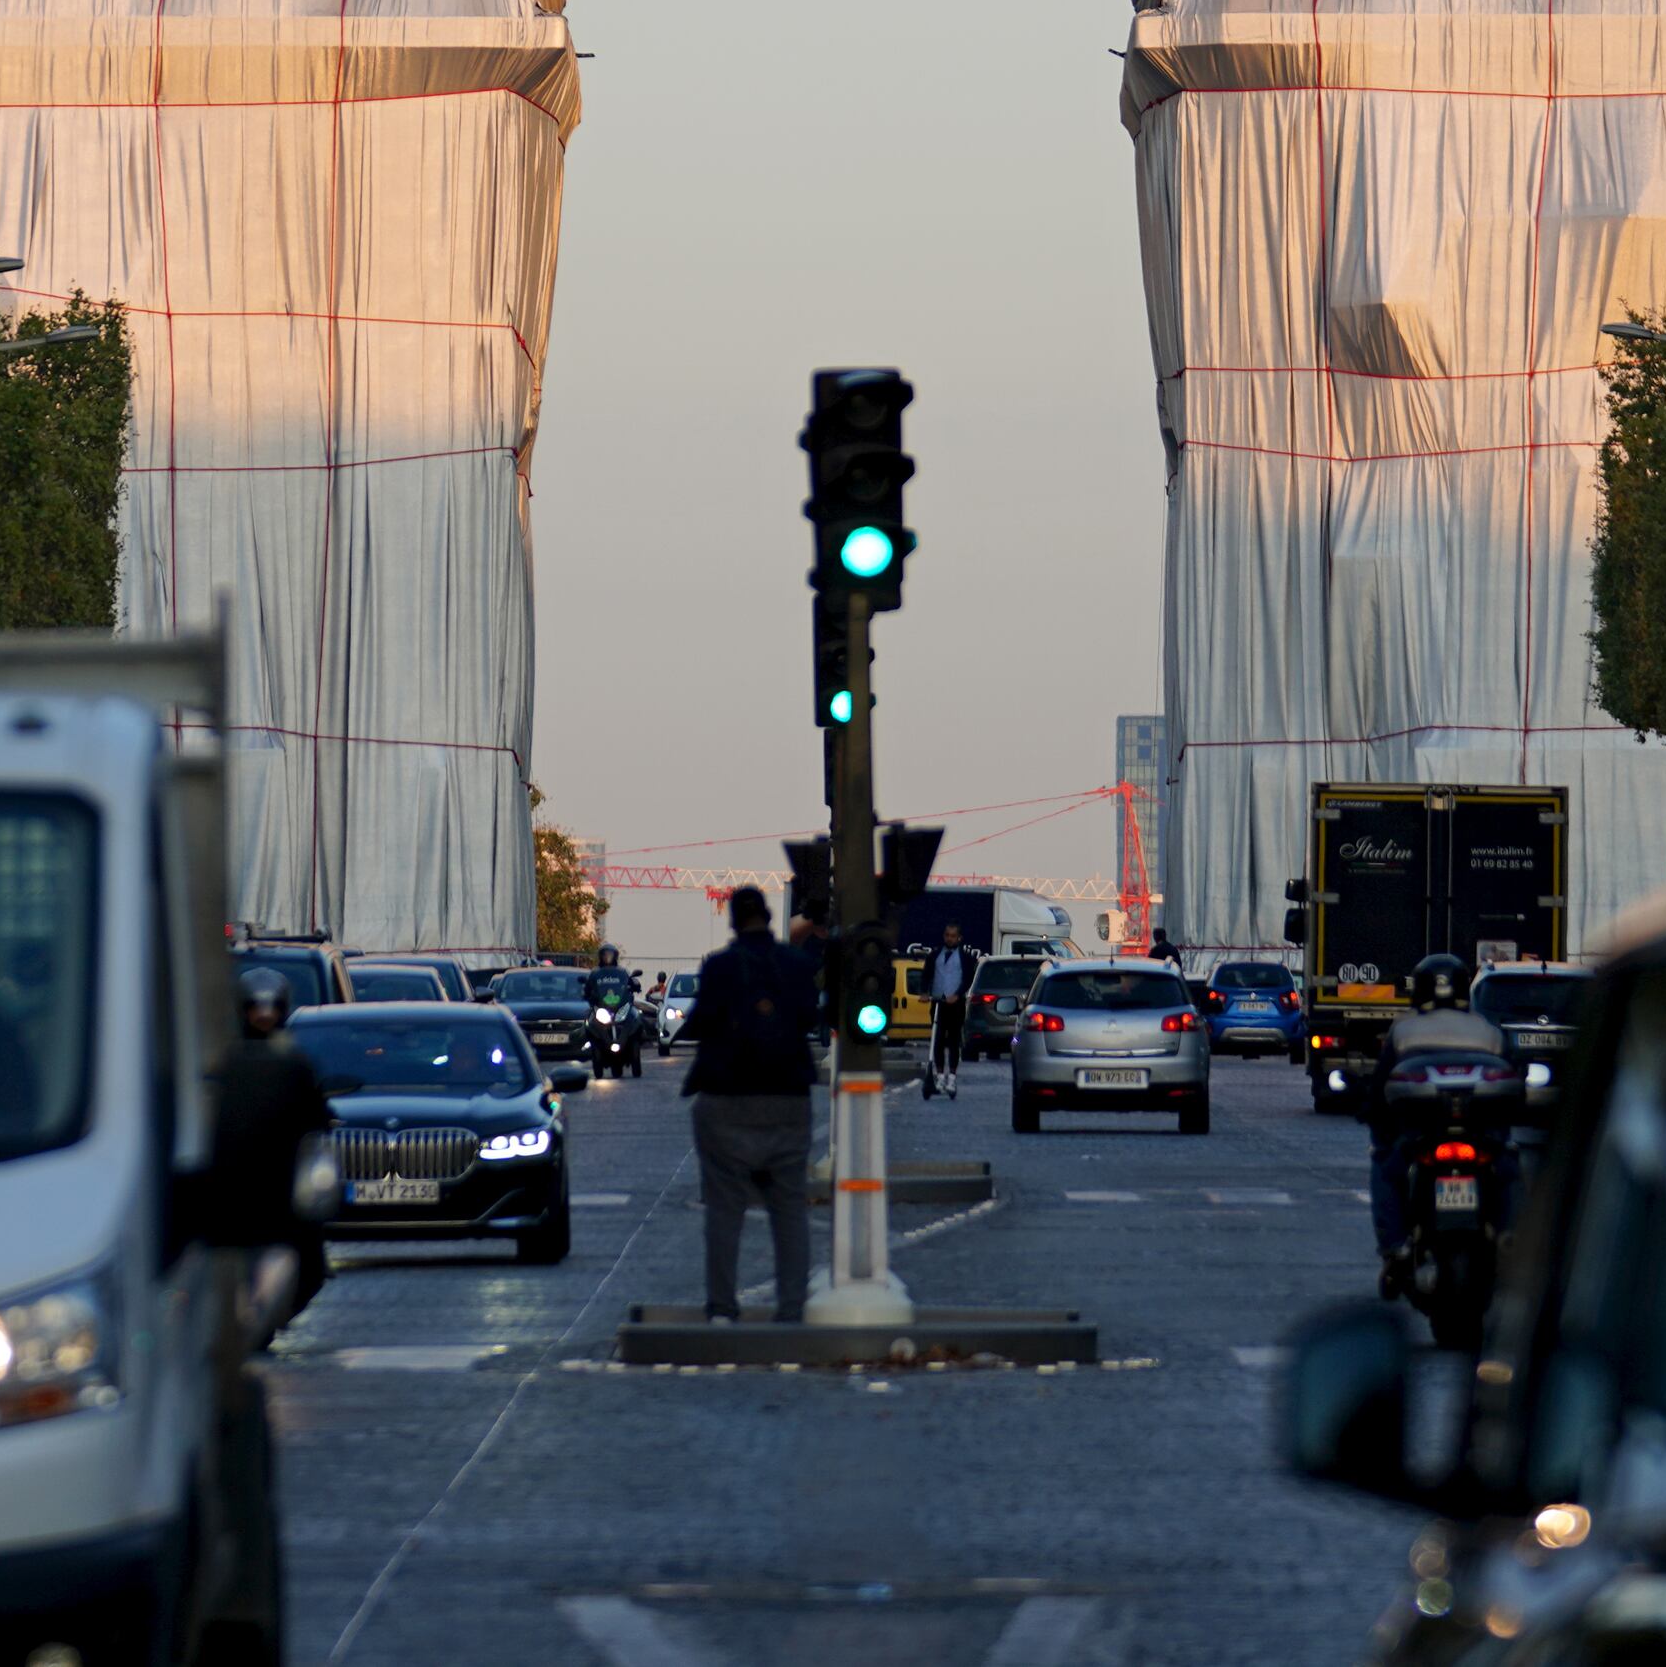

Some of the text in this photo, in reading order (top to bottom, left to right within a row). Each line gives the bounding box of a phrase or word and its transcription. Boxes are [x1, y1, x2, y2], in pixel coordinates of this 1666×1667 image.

[1339, 835, 1413, 860] Italim
[1470, 845, 1534, 855] www.italim.fr
[1470, 859, 1482, 868] 01
[1522, 860, 1534, 869] 40
[1342, 965, 1355, 982] 80
[1361, 965, 1376, 982] 90
